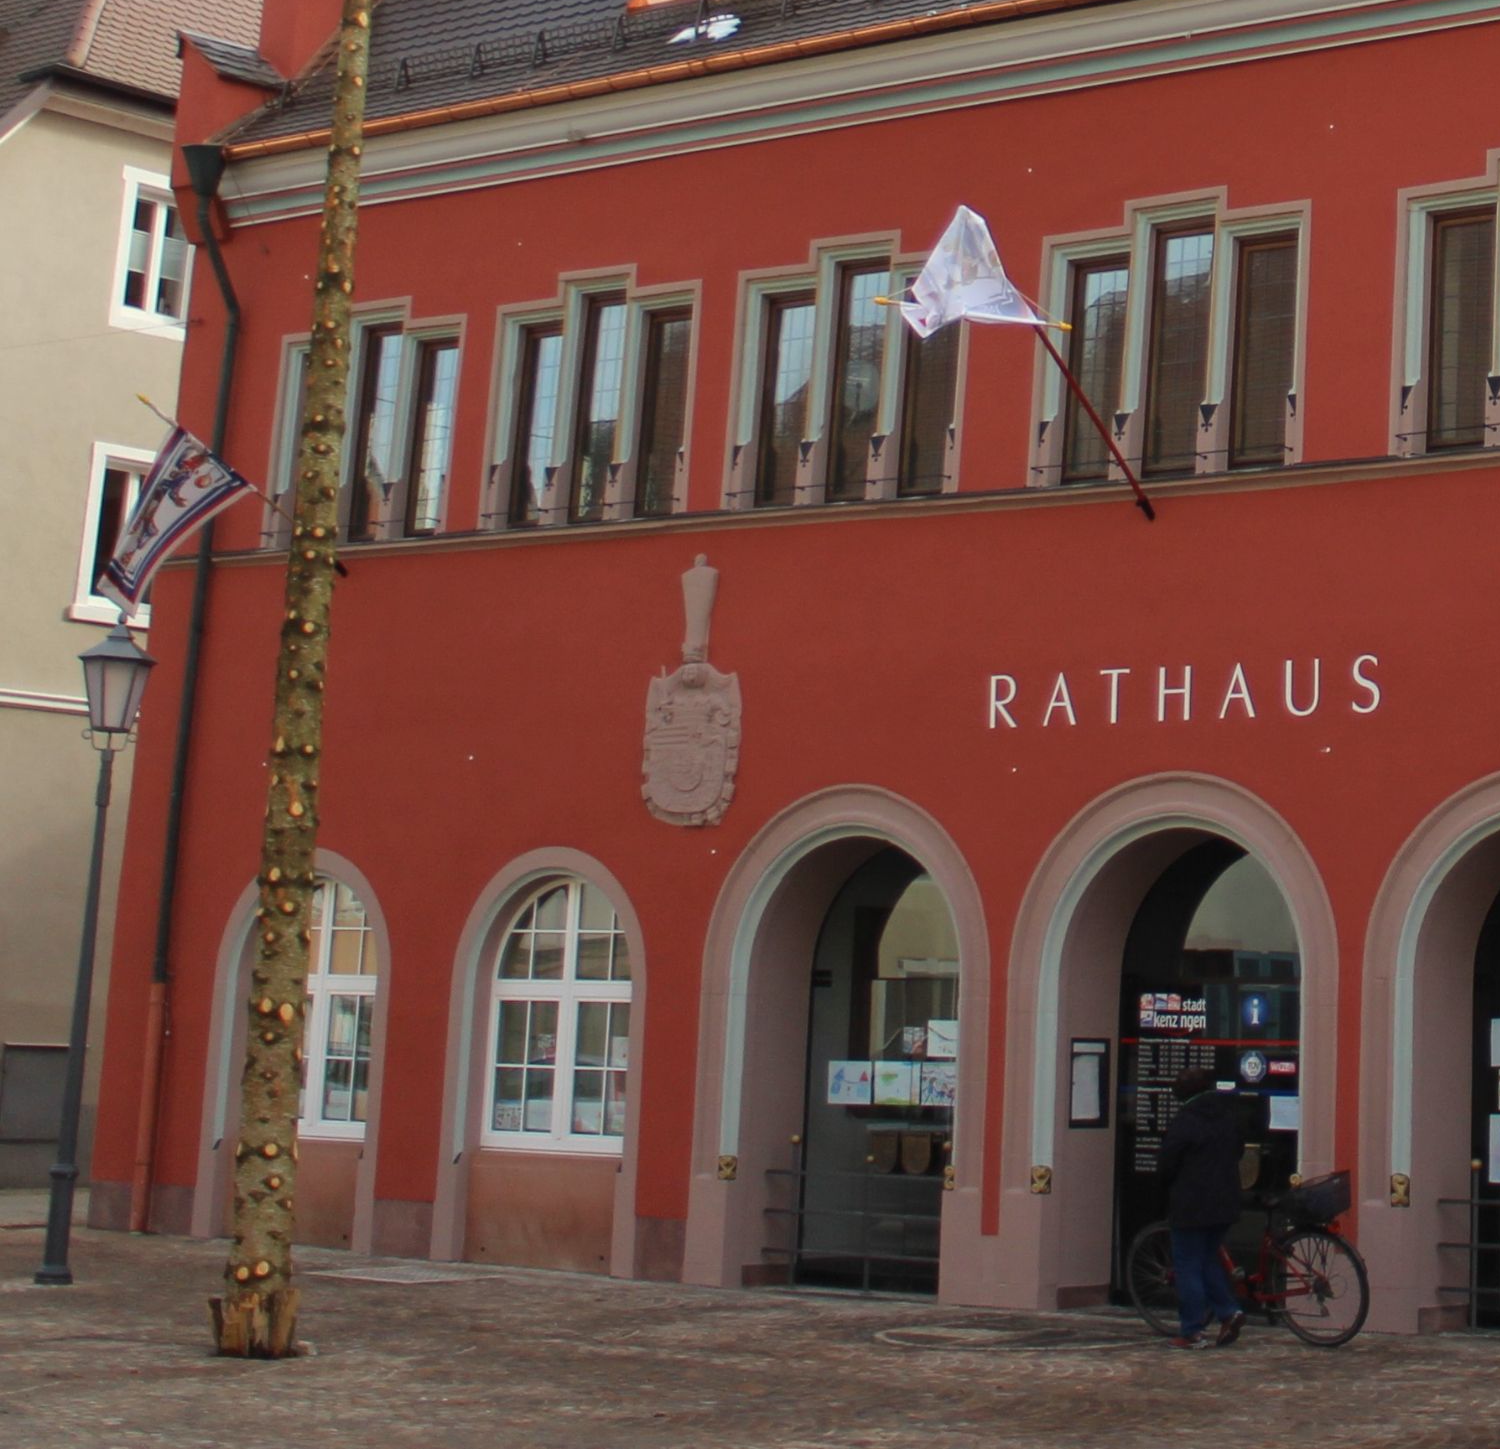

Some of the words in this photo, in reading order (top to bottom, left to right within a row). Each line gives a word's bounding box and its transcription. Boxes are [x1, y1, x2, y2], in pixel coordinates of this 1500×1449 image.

[989, 655, 1381, 729] RATHAUS
[1182, 1000, 1207, 1012] stadt
[1153, 1012, 1207, 1032] kenzngen
